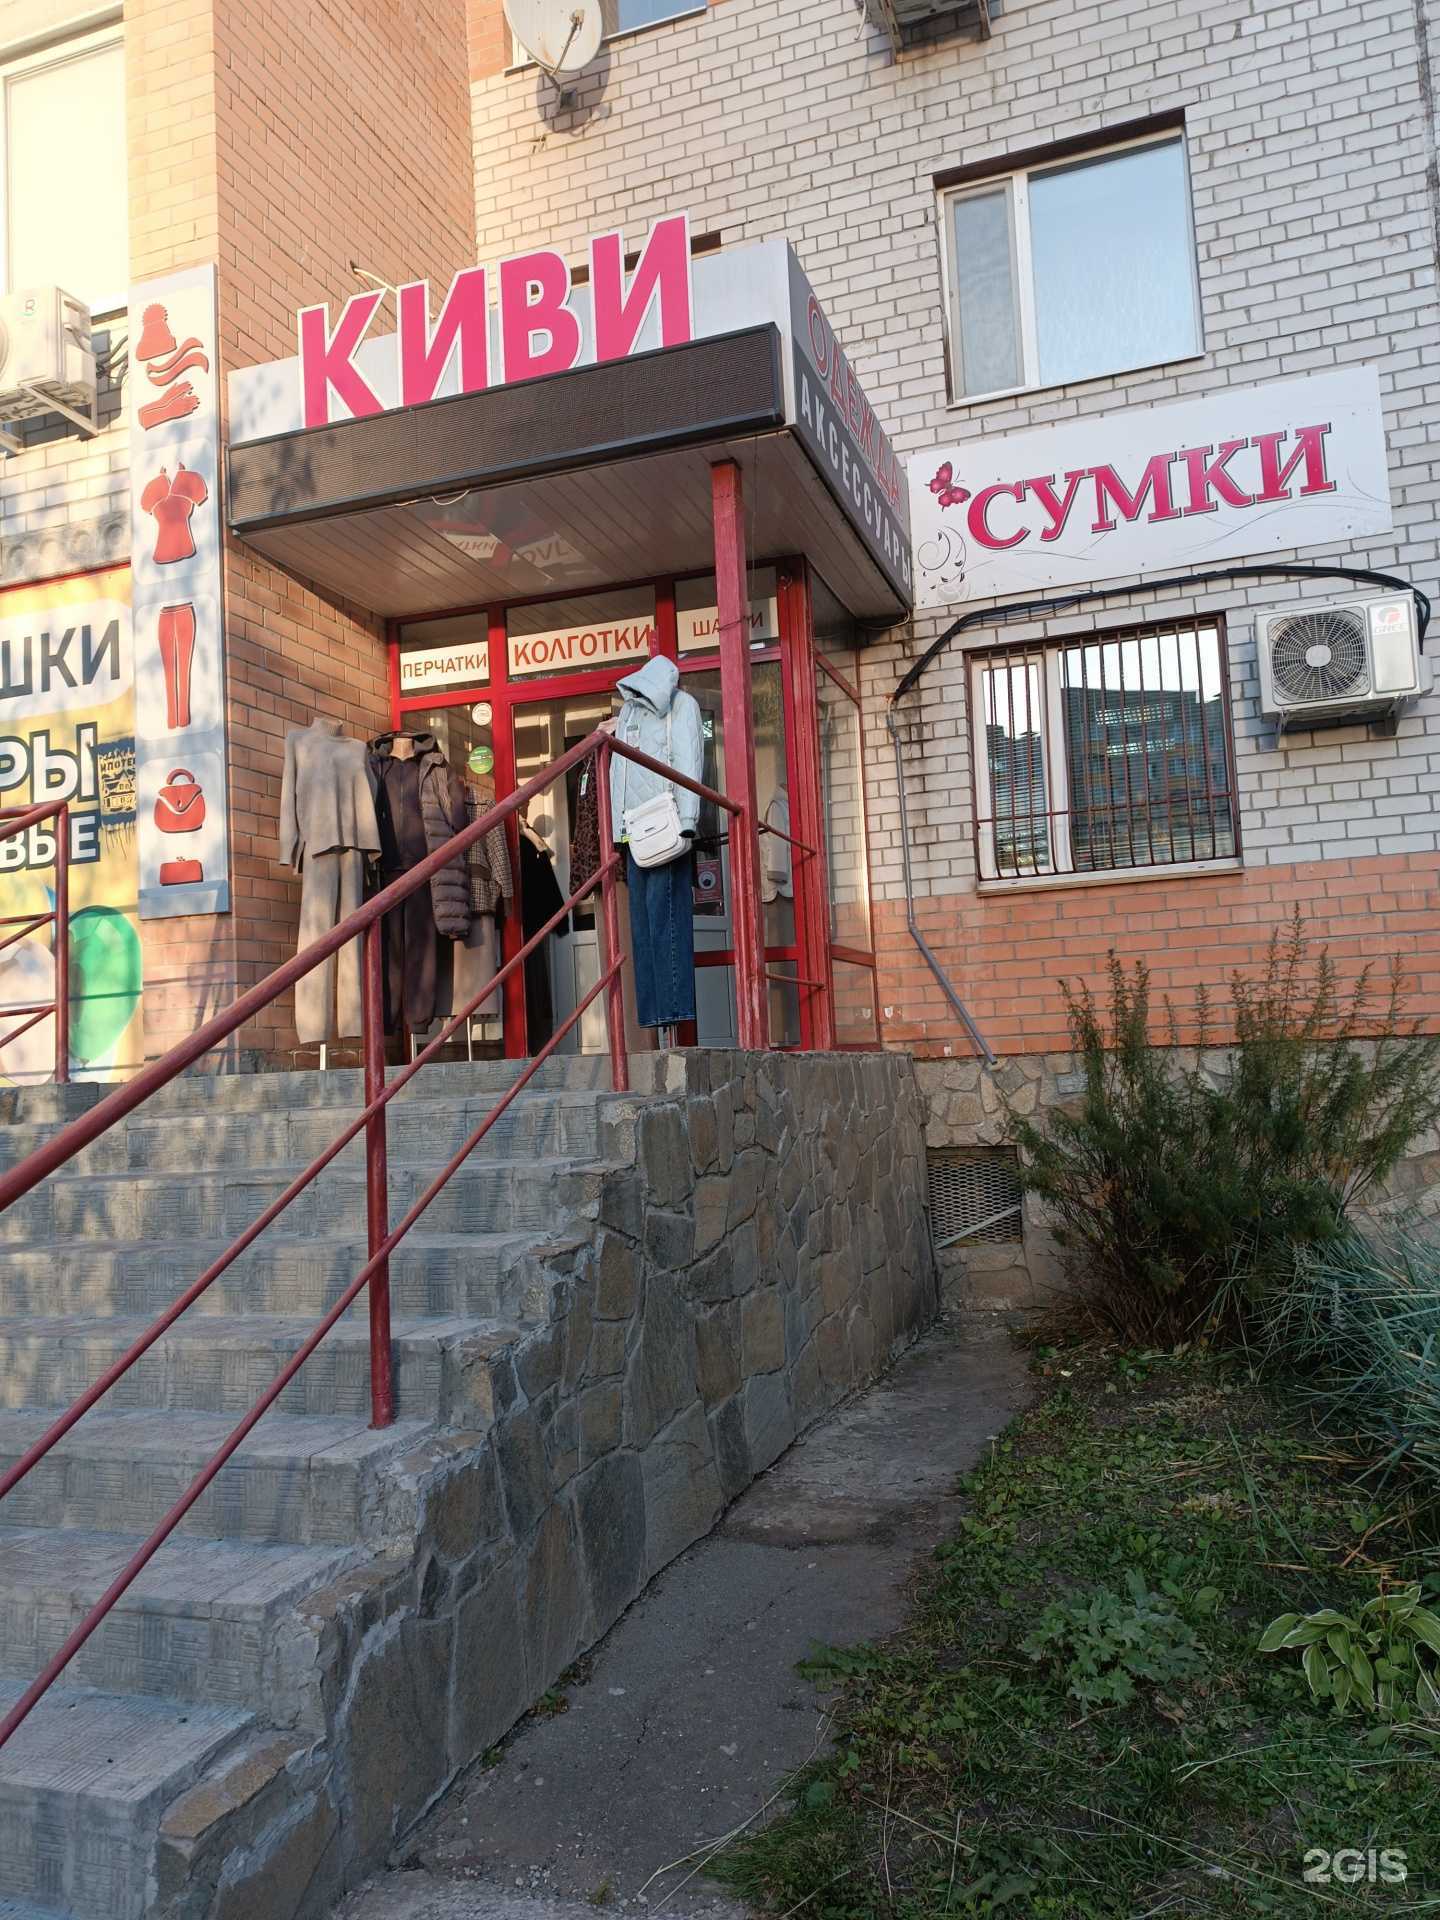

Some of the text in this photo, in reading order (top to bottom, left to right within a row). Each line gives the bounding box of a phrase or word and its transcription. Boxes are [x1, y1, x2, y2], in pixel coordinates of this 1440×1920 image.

[299, 213, 692, 428] КИВИ
[807, 294, 903, 516] ОДЕЖДА
[801, 373, 912, 590] АКСЕССУАРЫ
[967, 422, 1336, 550] СУМКИ
[402, 653, 488, 678] ПЕРЧАТКИ
[514, 624, 651, 666] КОЛГОТКИ
